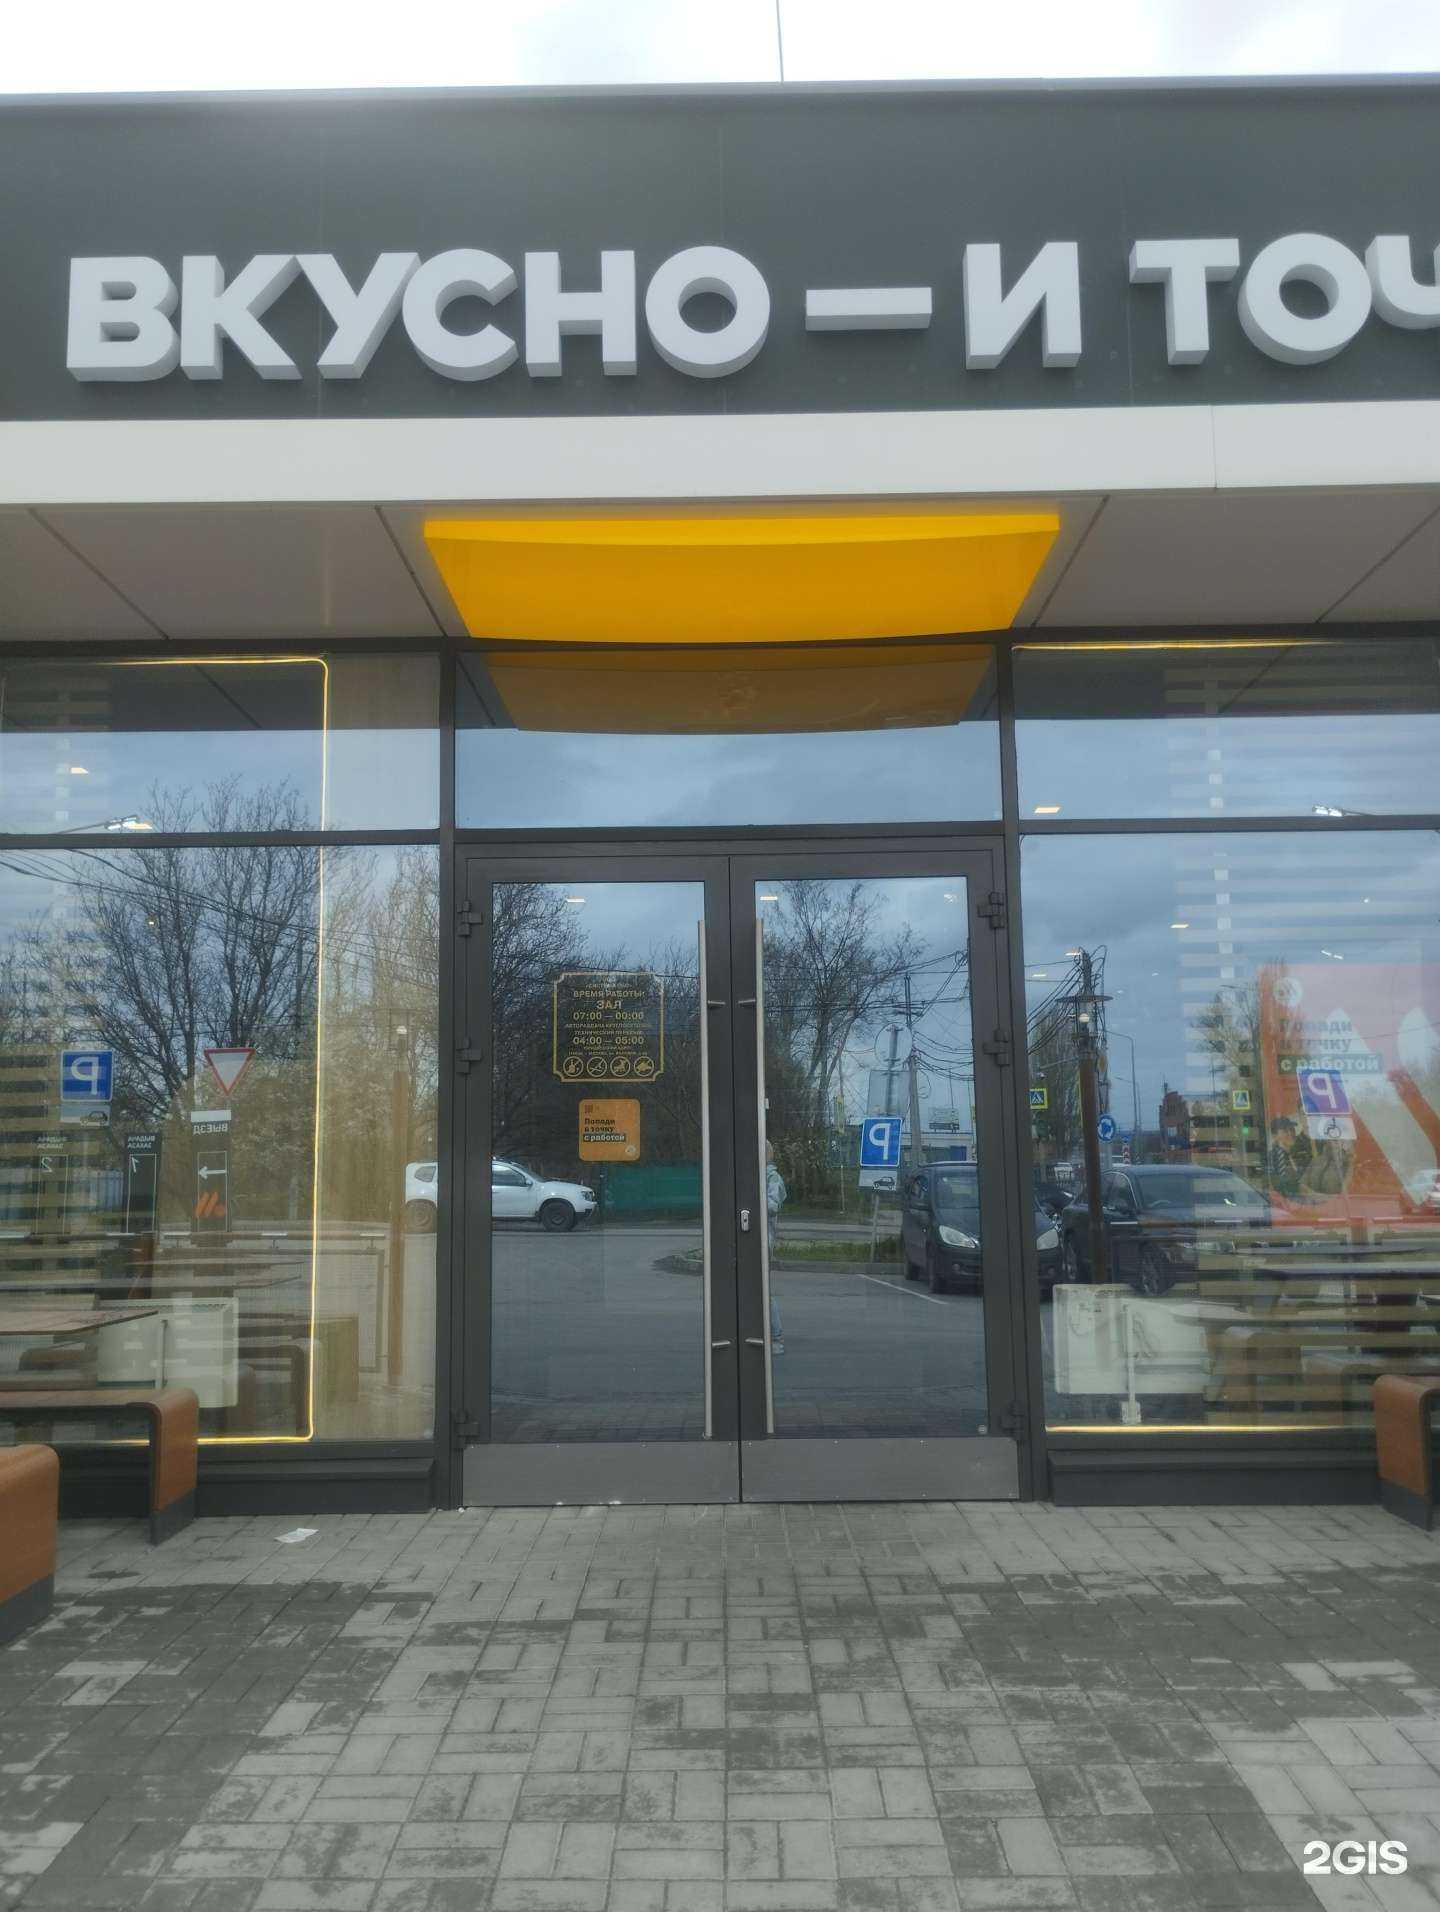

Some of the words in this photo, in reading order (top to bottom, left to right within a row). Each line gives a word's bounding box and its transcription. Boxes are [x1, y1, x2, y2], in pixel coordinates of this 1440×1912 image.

[66, 245, 771, 382] ВКУСНО
[962, 241, 1082, 370] И
[573, 990, 604, 998] ВРЕМЯ
[596, 1000, 622, 1010] ЗАЛ
[573, 1011, 602, 1020] 07:00
[615, 1011, 645, 1020] 00:00
[572, 1036, 602, 1045] 04:00
[615, 1036, 645, 1045] 05:00
